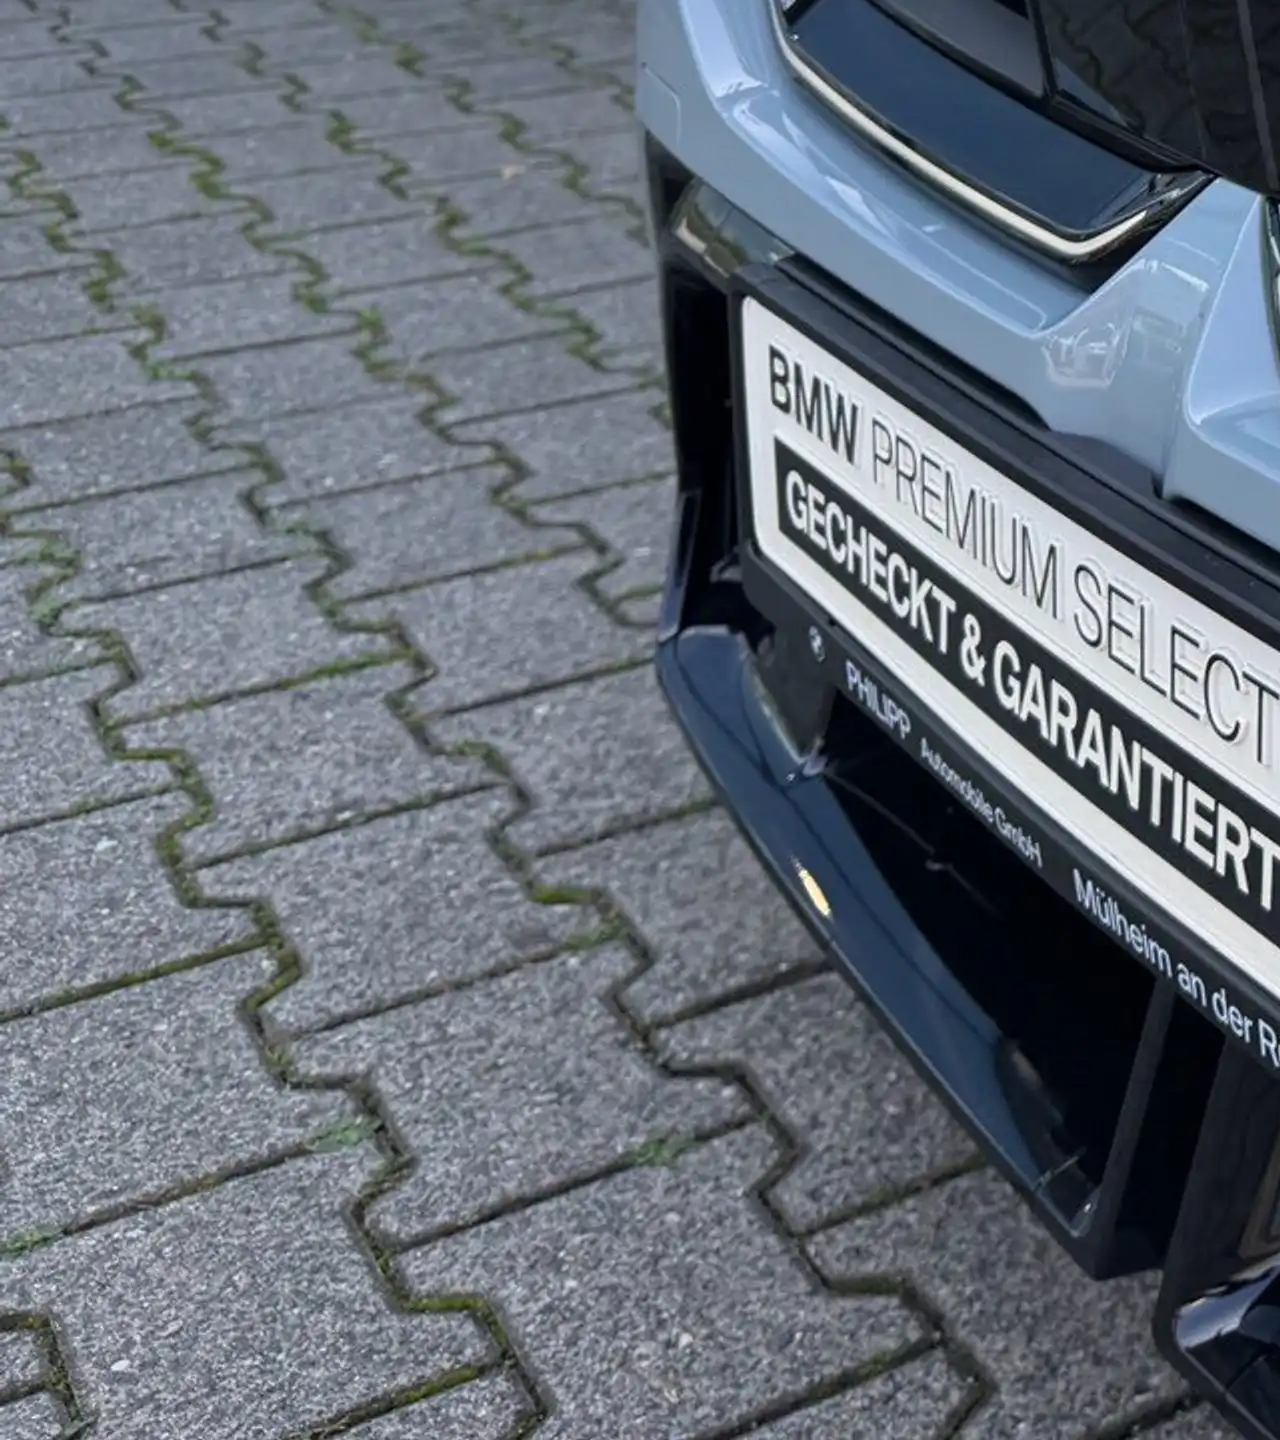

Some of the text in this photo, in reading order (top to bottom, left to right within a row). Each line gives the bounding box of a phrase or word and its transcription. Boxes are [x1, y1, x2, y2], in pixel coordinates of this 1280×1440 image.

[769, 343, 861, 466] BMW
[871, 414, 1062, 620] PREMIUM
[785, 469, 957, 655] GECHECKT
[959, 613, 987, 688] &
[845, 659, 912, 740] PHILIPP
[919, 737, 995, 825] Automobile
[994, 805, 1044, 870] GmbH
[1072, 867, 1175, 980] Mülheim
[1176, 962, 1208, 1008] an
[1211, 989, 1254, 1045] der
